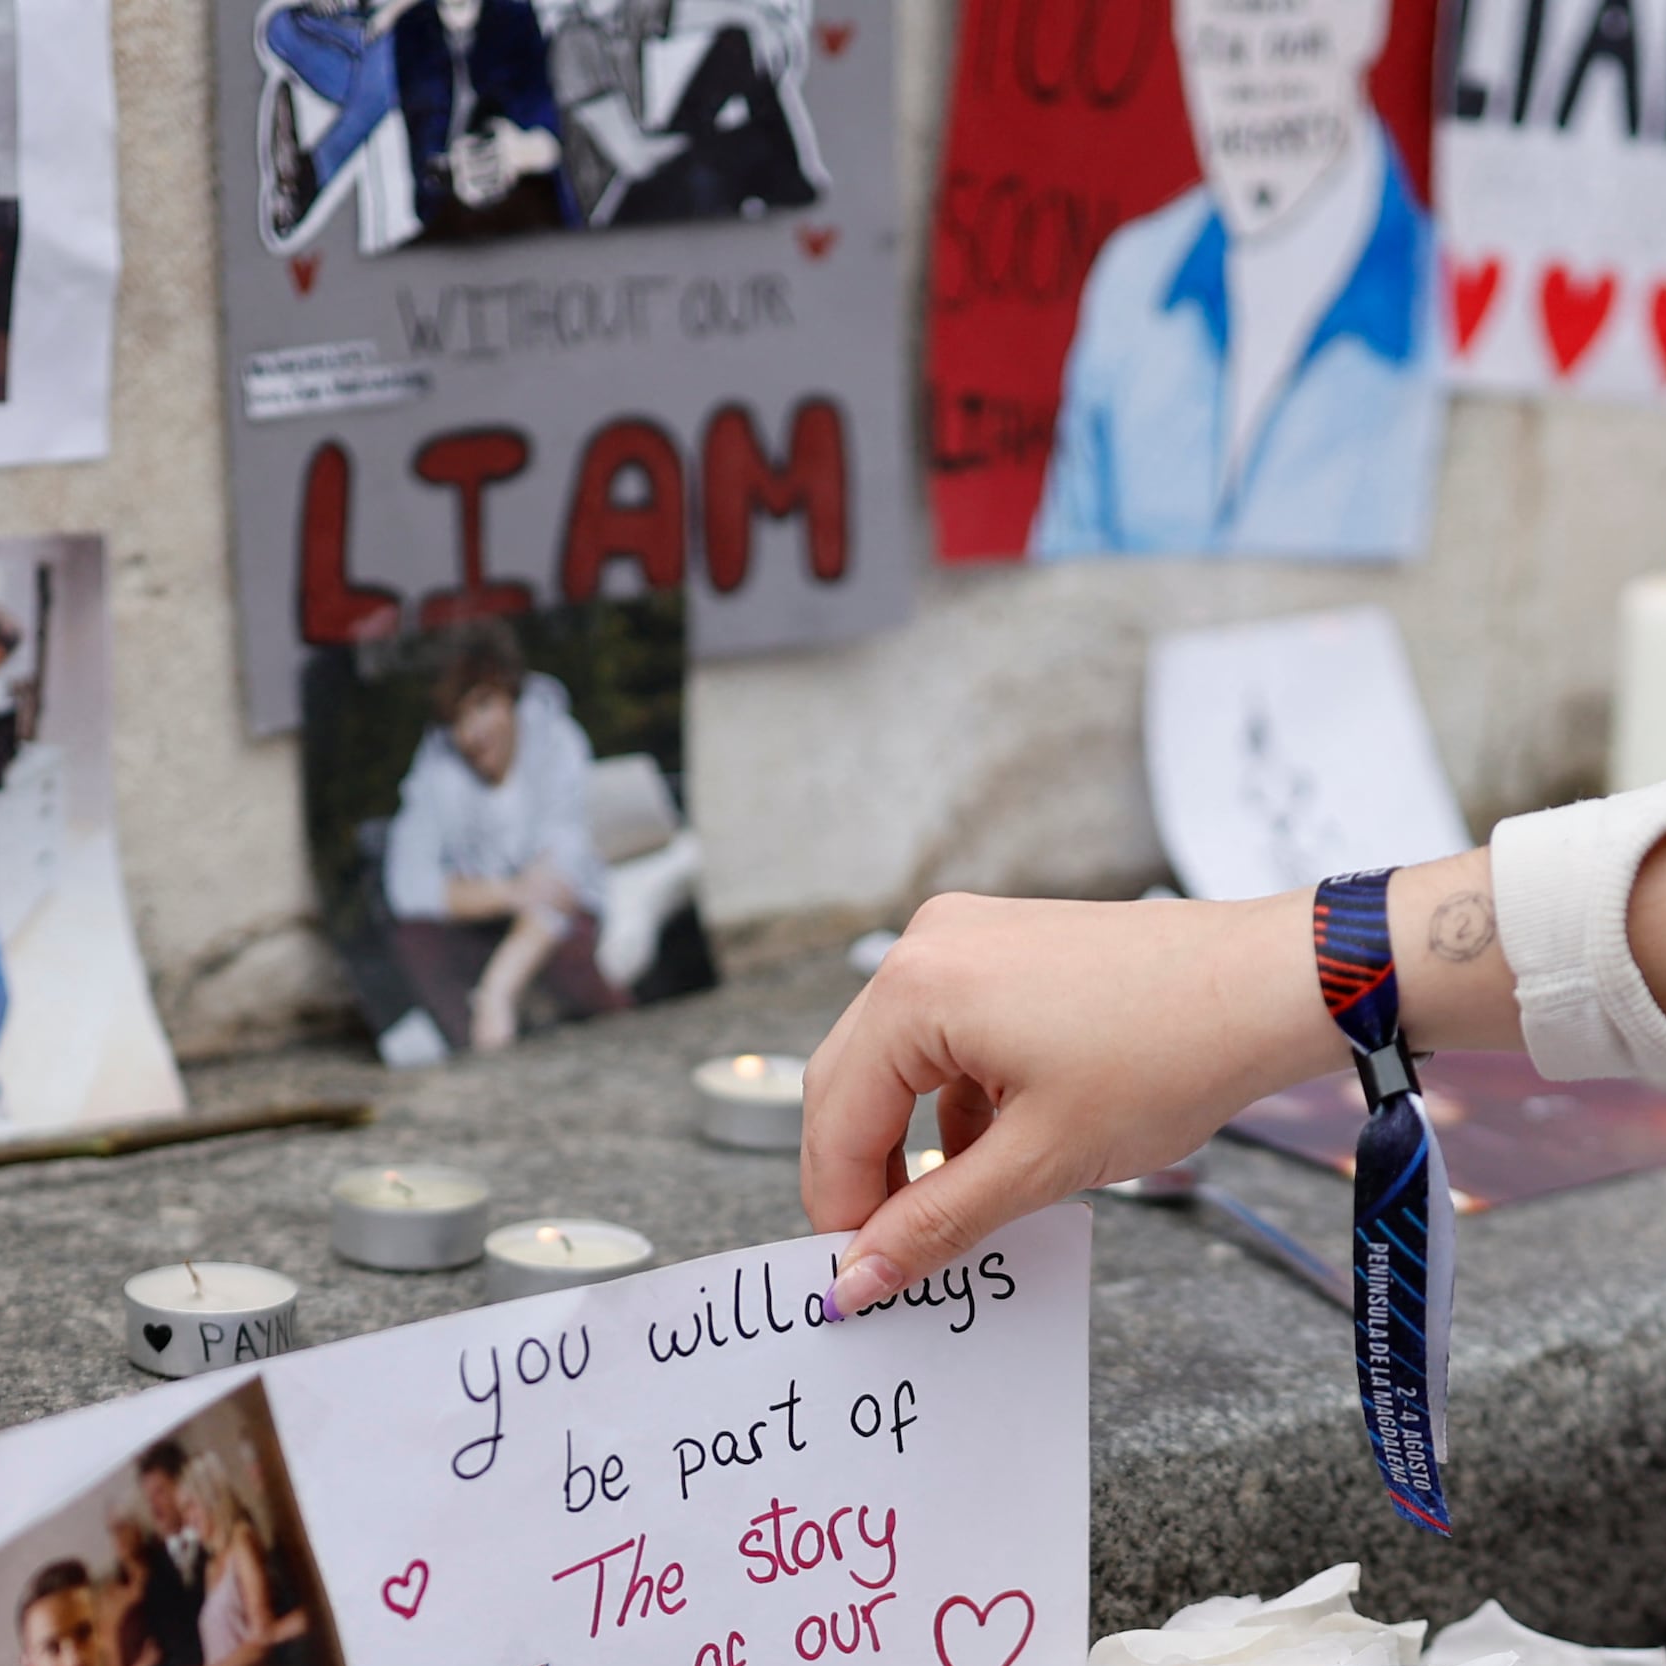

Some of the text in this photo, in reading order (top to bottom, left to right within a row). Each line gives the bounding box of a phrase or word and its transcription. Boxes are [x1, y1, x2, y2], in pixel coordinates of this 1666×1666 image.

[395, 270, 795, 358] WITHOUT OUR
[298, 394, 854, 648] LIAM
[451, 1325, 591, 1481] you
[647, 1262, 795, 1362] will
[1367, 1242, 1409, 1486] PENÍNSULA DE LA MAGDALENA
[564, 1379, 919, 1513] be part of
[1400, 1429, 1432, 1492] AGOSTO
[552, 1497, 898, 1638] The story
[795, 1591, 897, 1662] our
